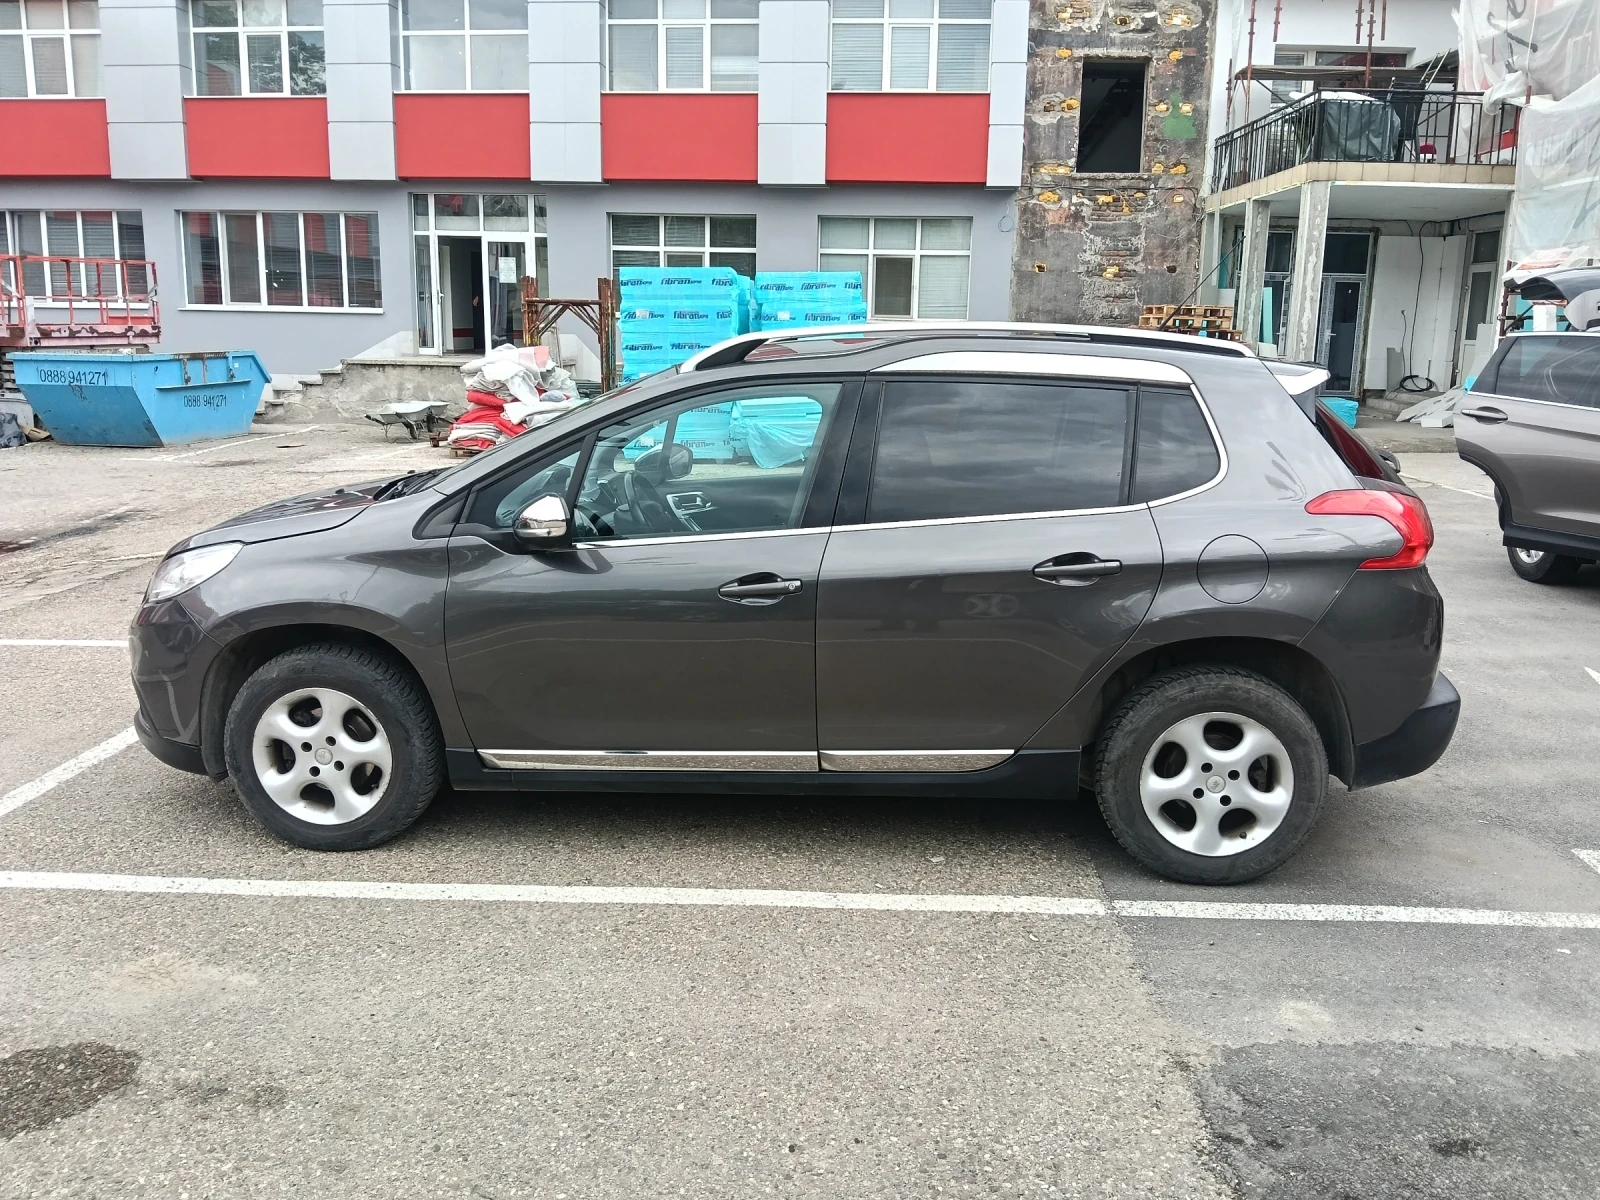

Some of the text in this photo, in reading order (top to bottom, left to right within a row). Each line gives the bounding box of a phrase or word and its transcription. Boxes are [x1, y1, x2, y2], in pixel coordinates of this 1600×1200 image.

[39, 369, 108, 386] 0888 941271
[183, 394, 228, 408] 0888 941271
